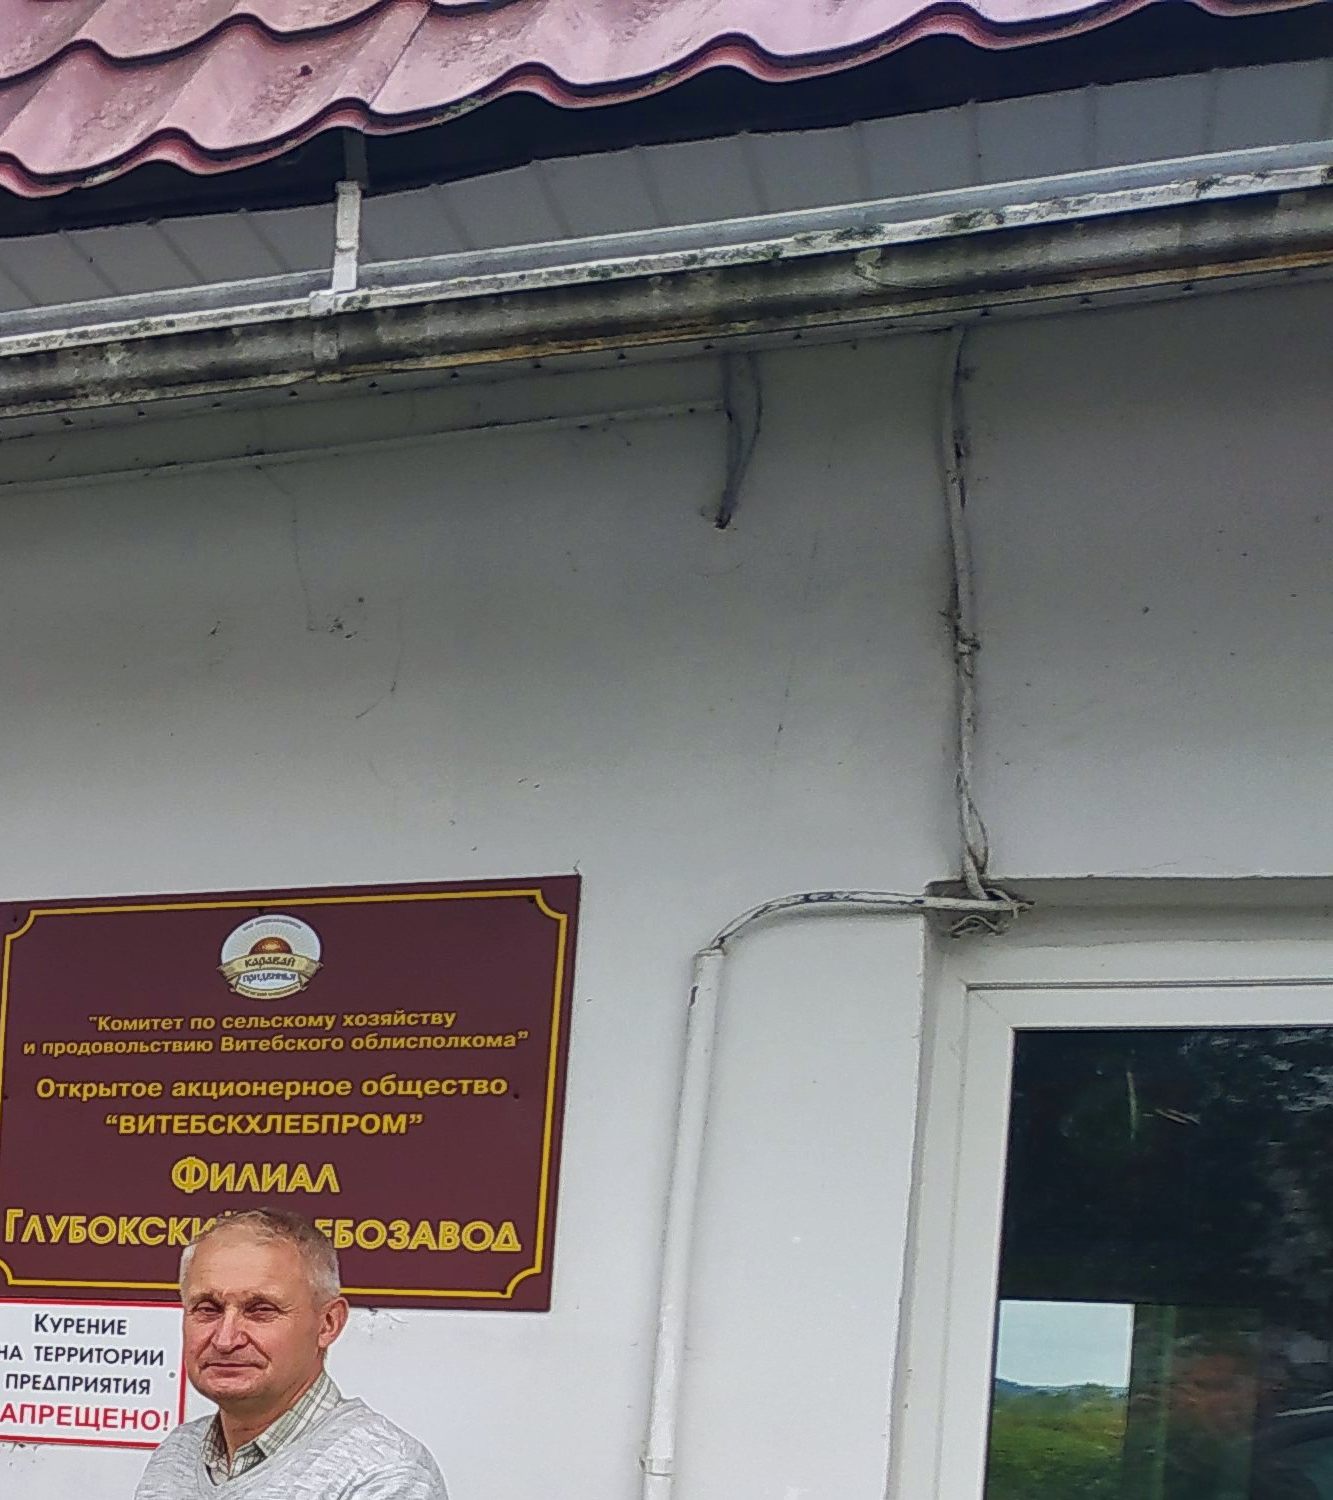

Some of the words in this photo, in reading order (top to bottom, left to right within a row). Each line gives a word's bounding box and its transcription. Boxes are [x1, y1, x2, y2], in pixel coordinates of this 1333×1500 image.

[190, 1018, 215, 1030] по
[221, 1014, 336, 1031] сельскому
[342, 1010, 456, 1029] хозяйству
[23, 1042, 35, 1055] и
[42, 1040, 213, 1058] продовольствию
[220, 1035, 344, 1052] Витебского
[36, 1078, 163, 1101] Открытое
[172, 1079, 352, 1101] акционерное
[361, 1074, 508, 1098] общество
[105, 1113, 423, 1134] “ВИТЕБСКХЛЕБПРОМ”
[5, 1209, 229, 1246] ГЛУБОКСКИ
[315, 1219, 521, 1251] ЕБОЗАВОД
[34, 1346, 164, 1366] ТЕРРИТОРИИ
[5, 1374, 151, 1395] ПРЕДПРИЯТИЯ
